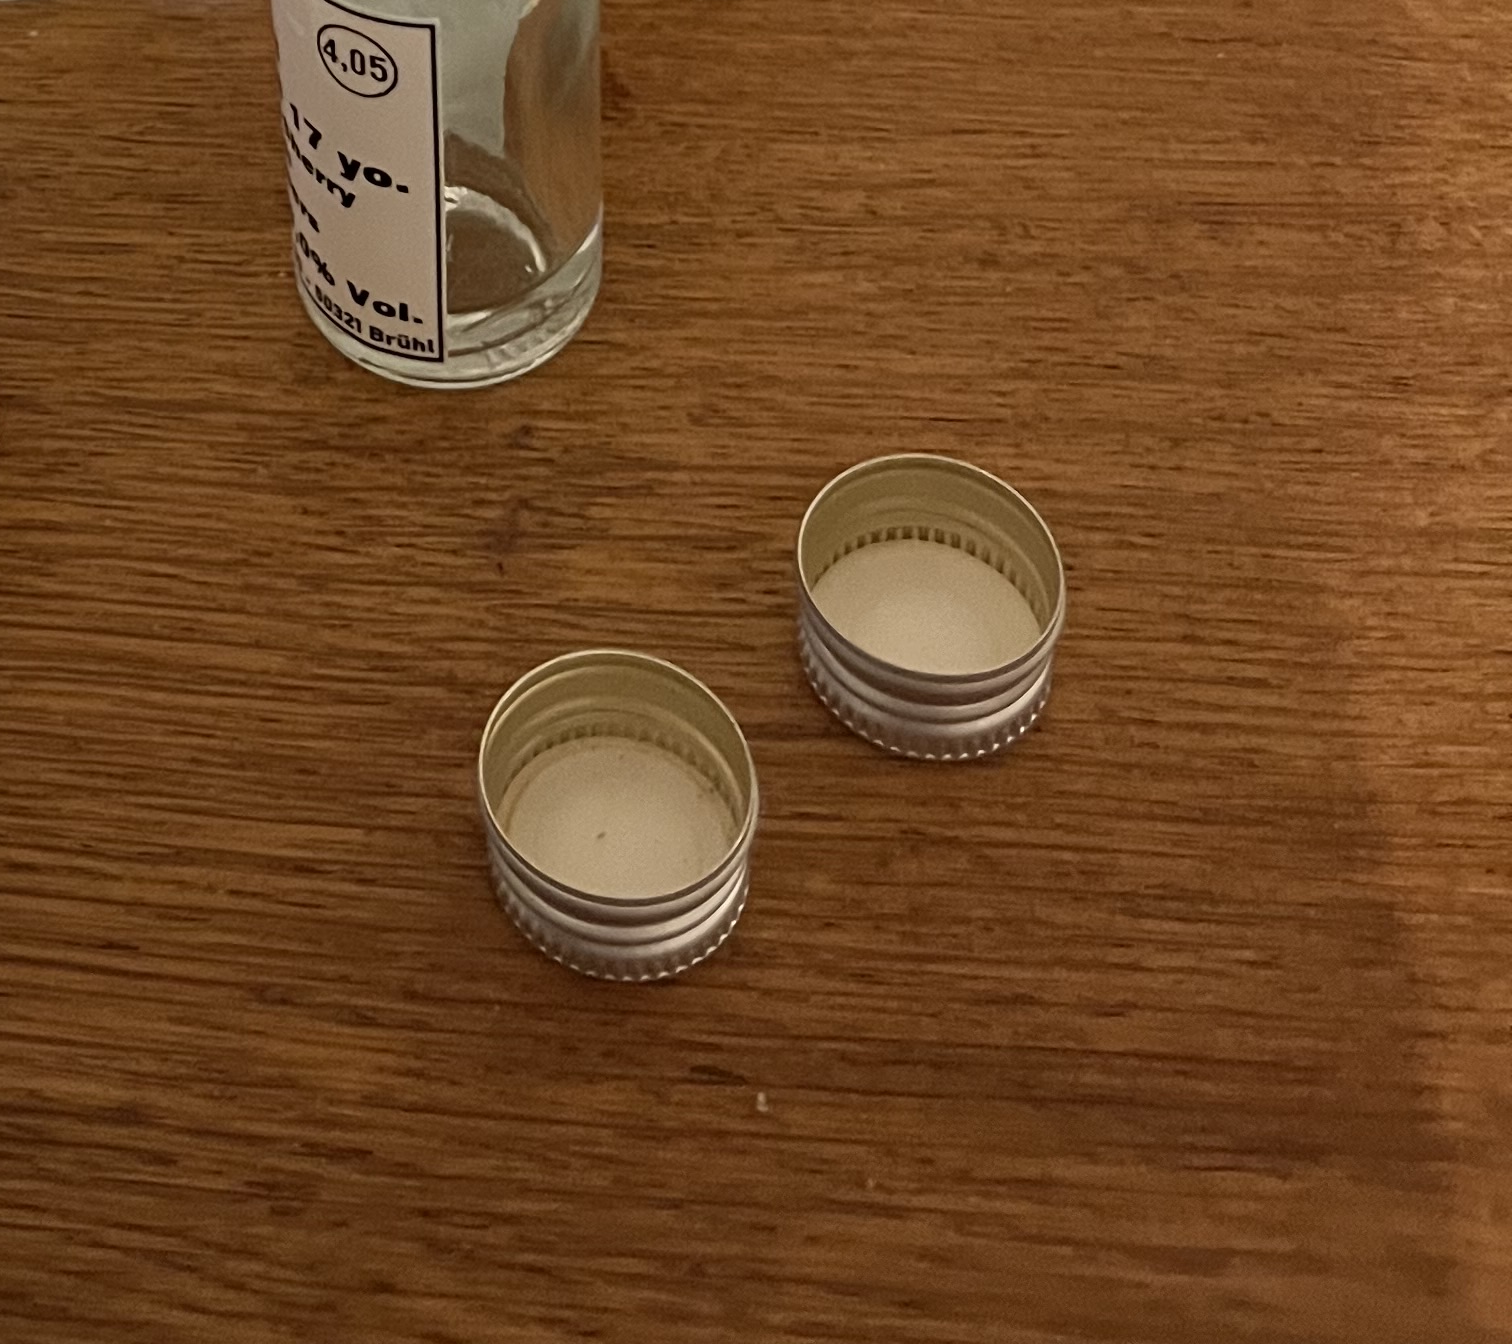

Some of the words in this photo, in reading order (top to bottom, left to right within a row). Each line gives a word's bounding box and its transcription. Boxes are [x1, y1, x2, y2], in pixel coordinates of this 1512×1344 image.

[323, 38, 389, 84] 4,05
[289, 102, 323, 151] 17
[337, 150, 410, 194] yo.
[295, 231, 336, 287] 0%
[346, 279, 424, 325] Vol.
[368, 325, 436, 354] Brühl
